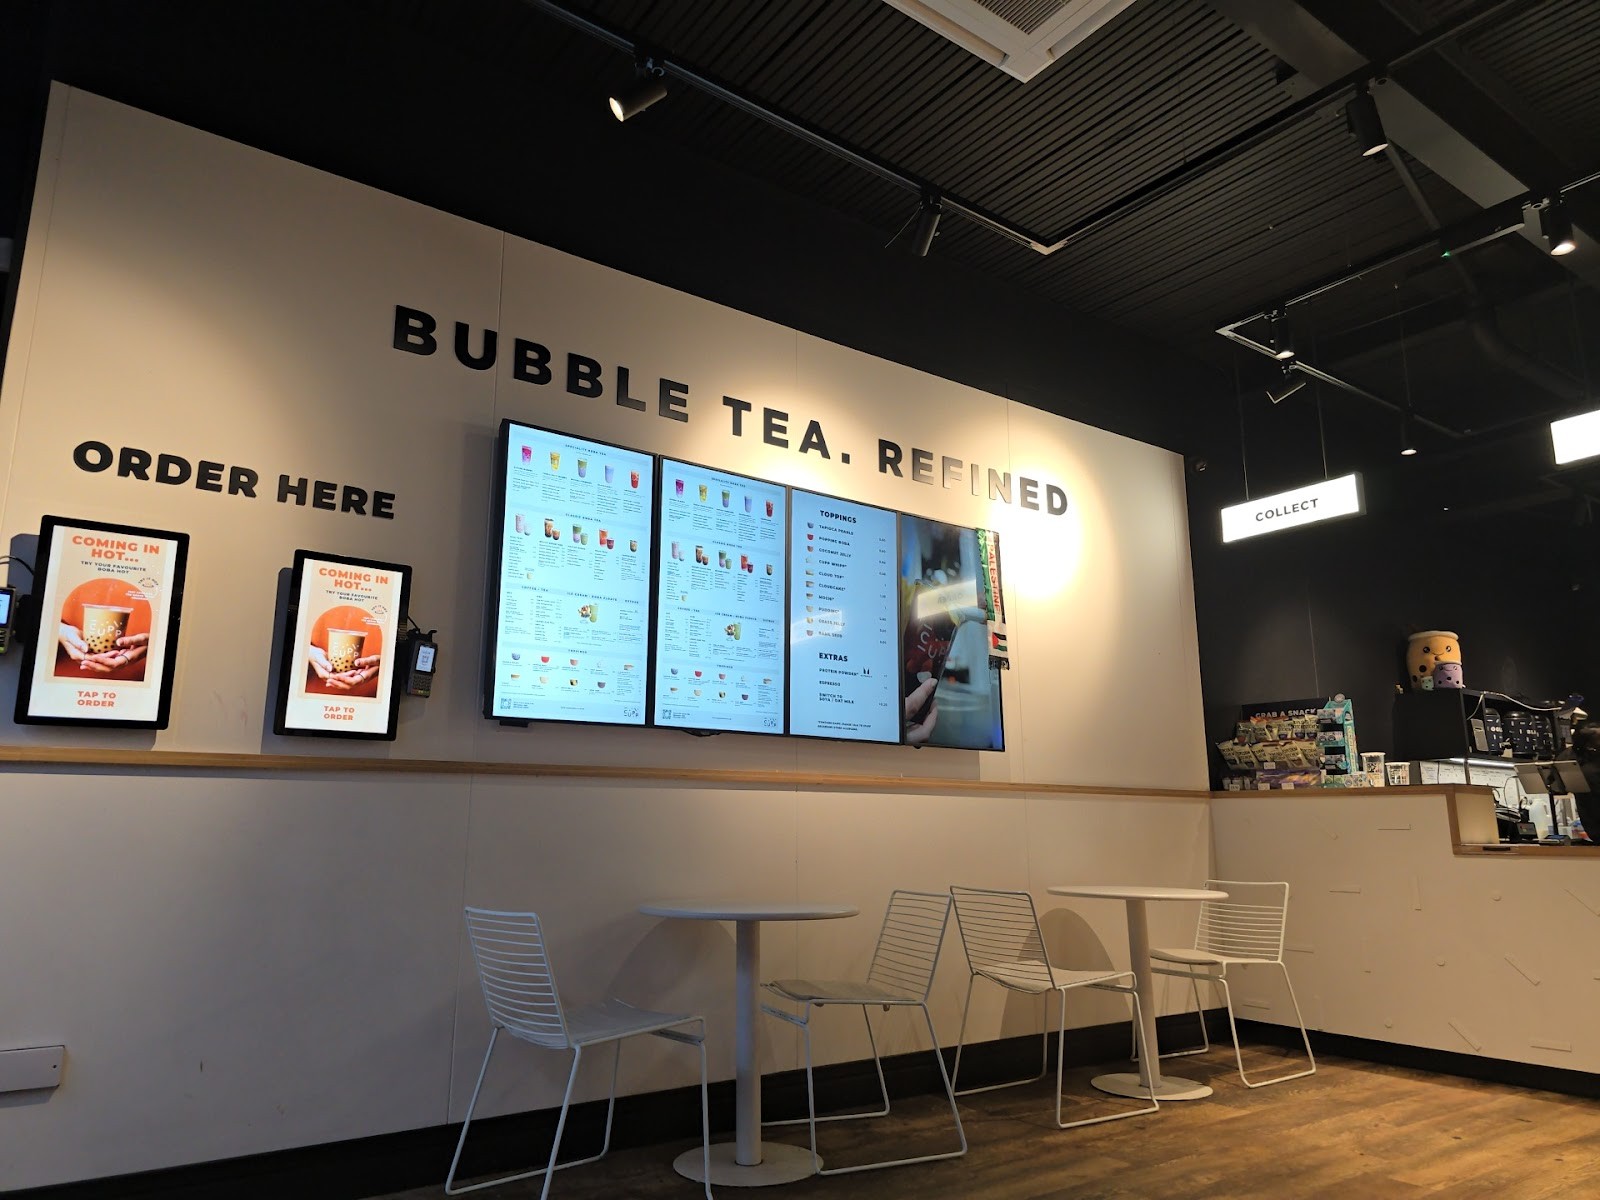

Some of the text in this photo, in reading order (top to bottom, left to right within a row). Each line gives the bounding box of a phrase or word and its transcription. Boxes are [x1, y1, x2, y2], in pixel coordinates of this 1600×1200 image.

[393, 304, 1068, 516] BUBBLE TEA. REFINED
[73, 440, 396, 520] ORDER HERE
[820, 510, 857, 524] TOPPINGS
[1255, 498, 1319, 522] COLLECT
[72, 535, 160, 555] COMING IN
[113, 564, 147, 572] FAVOURITE
[319, 567, 389, 585] COMING IN
[988, 544, 1001, 614] PALESTINE
[818, 652, 849, 662] EXTRAS
[77, 690, 99, 698] TAP
[77, 699, 115, 708] ORDER
[324, 713, 354, 721] ORDER
[1288, 708, 1317, 717] SNACK
